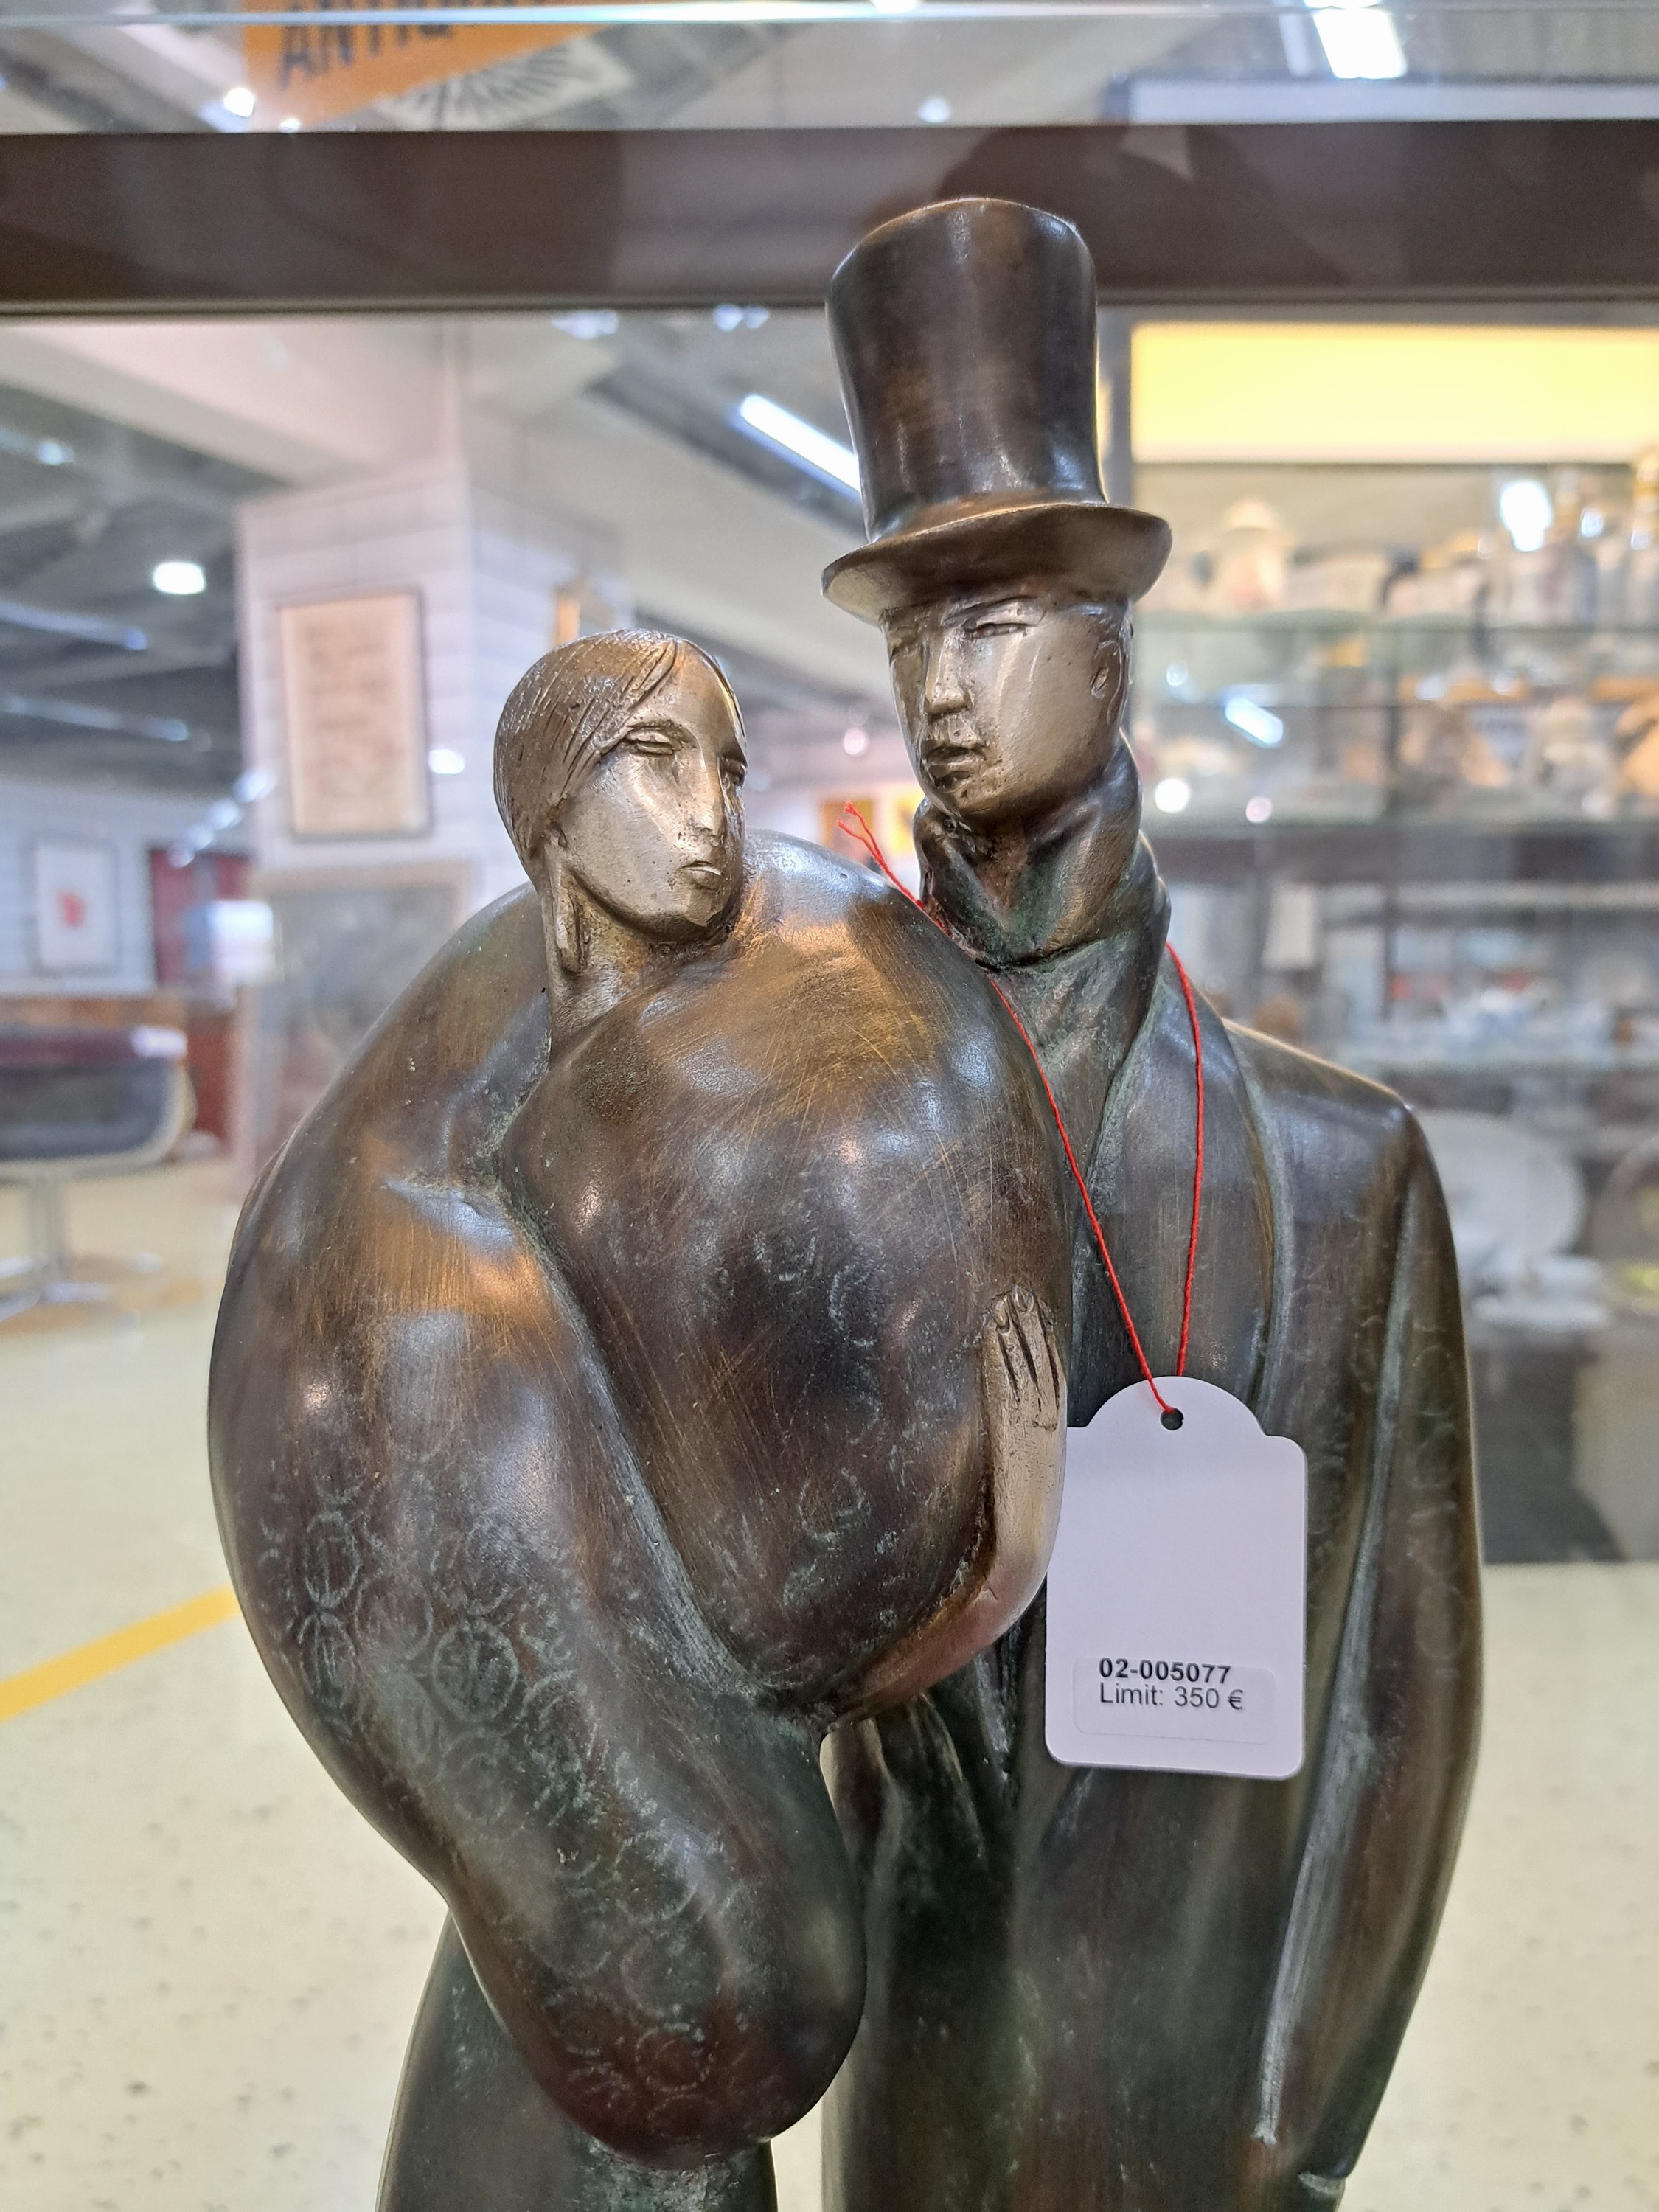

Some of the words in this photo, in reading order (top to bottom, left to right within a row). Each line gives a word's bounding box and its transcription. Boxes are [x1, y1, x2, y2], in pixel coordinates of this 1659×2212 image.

[1098, 1658, 1231, 1684] 02-005077
[1099, 1682, 1164, 1705] Limit:
[1174, 1686, 1220, 1709] 350
[1227, 1688, 1244, 1711] €
